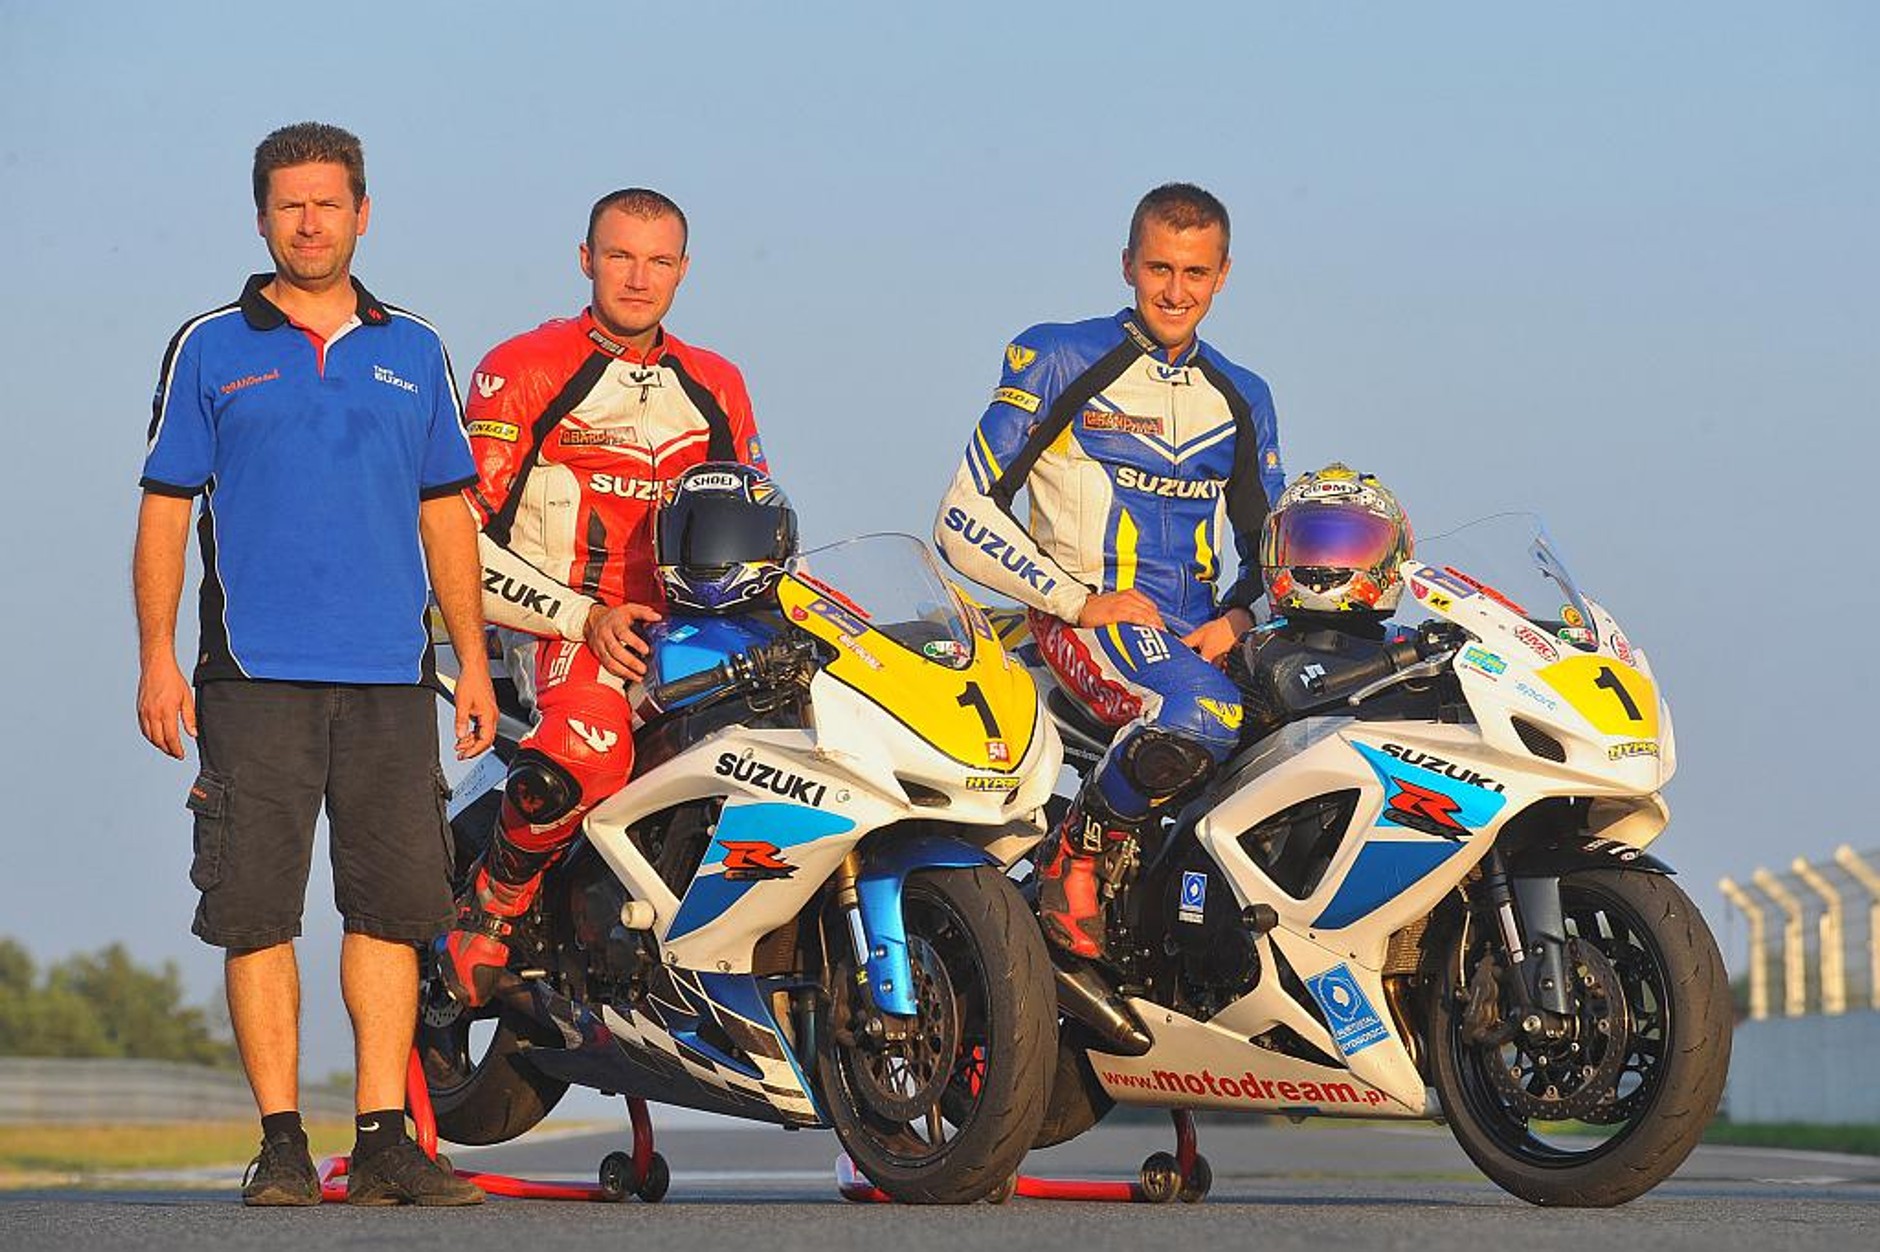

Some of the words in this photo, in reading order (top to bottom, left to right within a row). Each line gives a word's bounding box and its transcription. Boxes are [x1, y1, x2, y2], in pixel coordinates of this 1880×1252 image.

[589, 473, 663, 501] SUZ
[692, 475, 733, 487] SHOEI
[1116, 466, 1217, 499] SUZUKI
[944, 507, 1057, 596] SUZUKI
[481, 566, 561, 620] ZUKI
[956, 681, 1001, 738] 1
[1593, 666, 1643, 720] 1
[715, 752, 827, 807] SUZUKI
[1381, 743, 1505, 793] SUZUKI
[1103, 1069, 1388, 1106] www.motodream.pl
